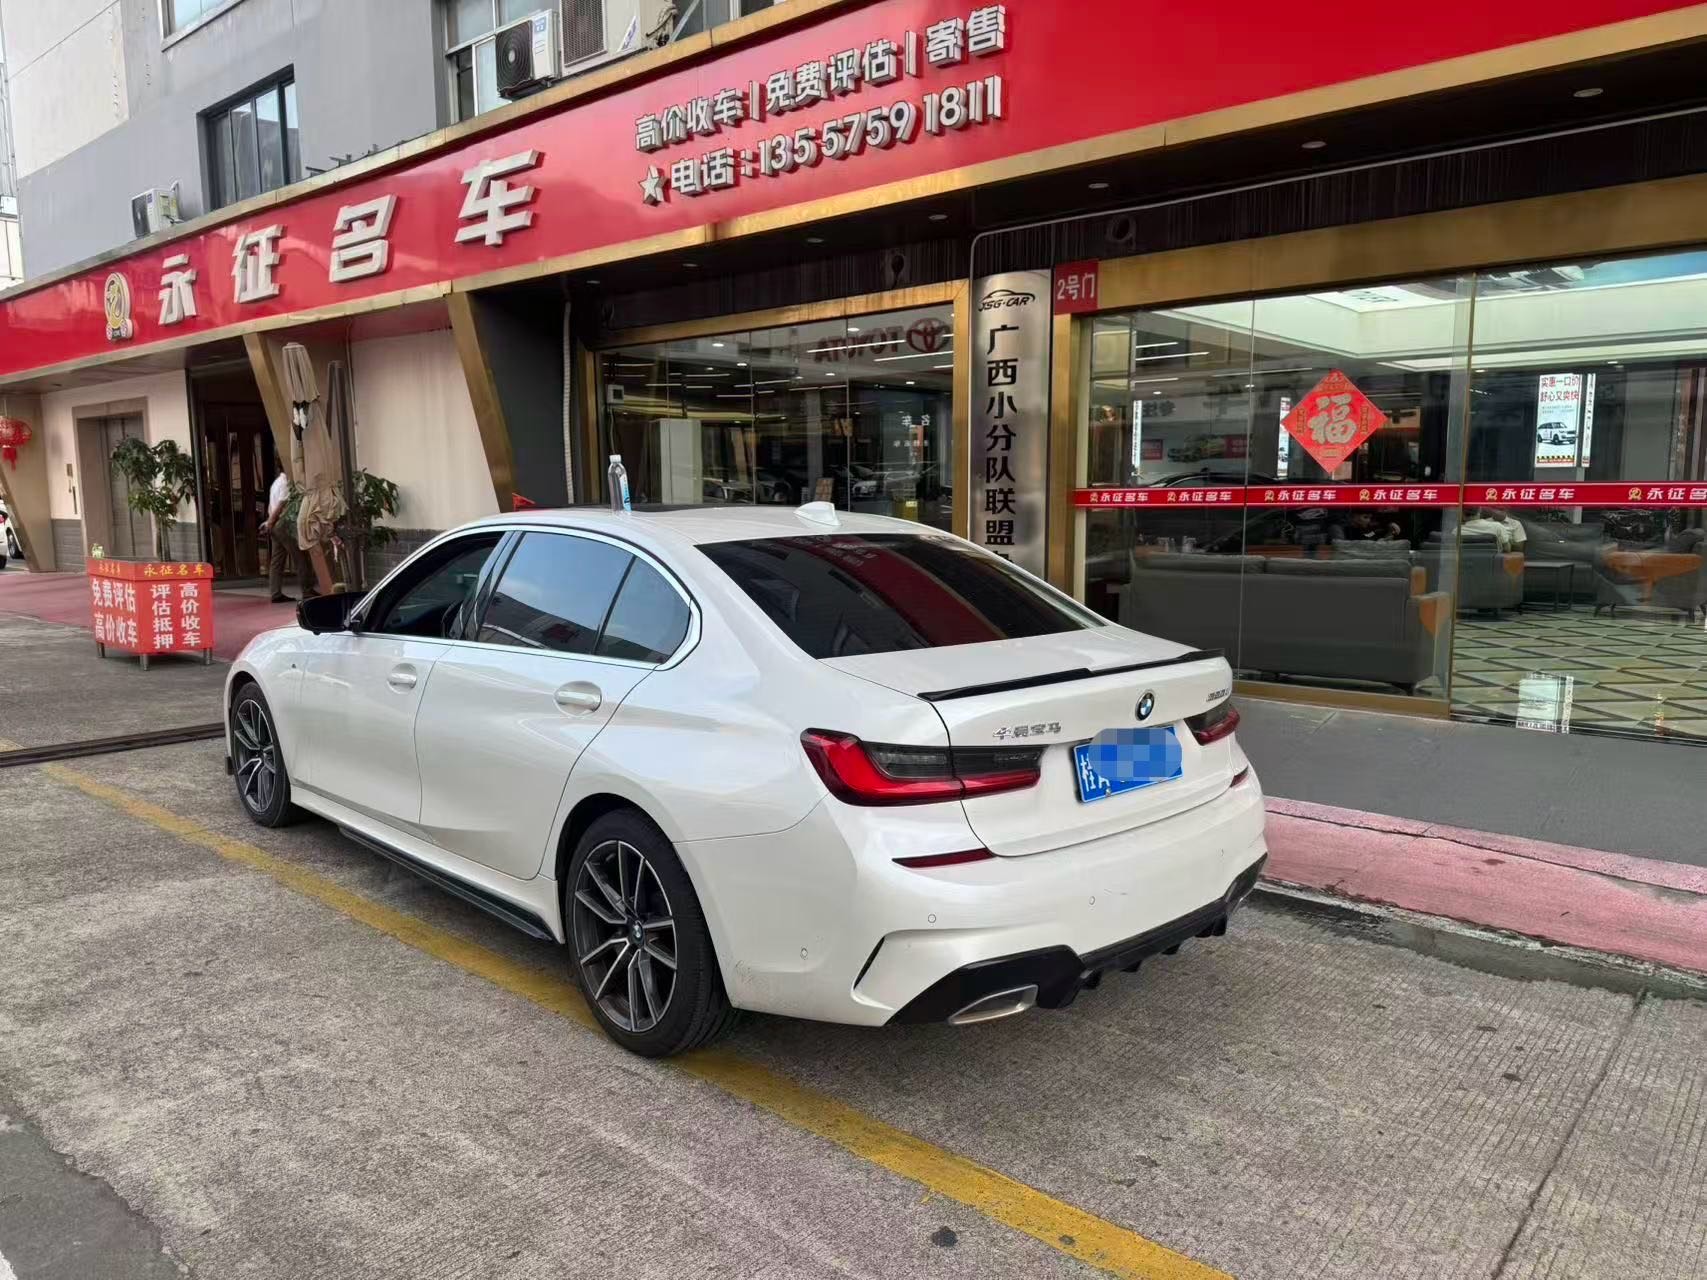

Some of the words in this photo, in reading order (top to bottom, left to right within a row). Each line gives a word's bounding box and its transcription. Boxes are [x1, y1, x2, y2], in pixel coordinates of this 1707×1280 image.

[158, 149, 540, 325] 永征名车
[1057, 273, 1096, 300] 2号门
[1307, 393, 1357, 445] 福
[1101, 492, 1149, 502] 永征名车
[1178, 491, 1233, 502] 永征名车
[1277, 490, 1337, 501] 永征名车
[1373, 489, 1438, 501] 永征名车
[1502, 488, 1576, 501] 永征名车
[143, 563, 205, 577] 永征名车
[92, 578, 136, 613] 免费评估
[93, 611, 138, 647] 高价收车
[150, 583, 174, 649] 评估抵押
[178, 582, 201, 646] 高价收车
